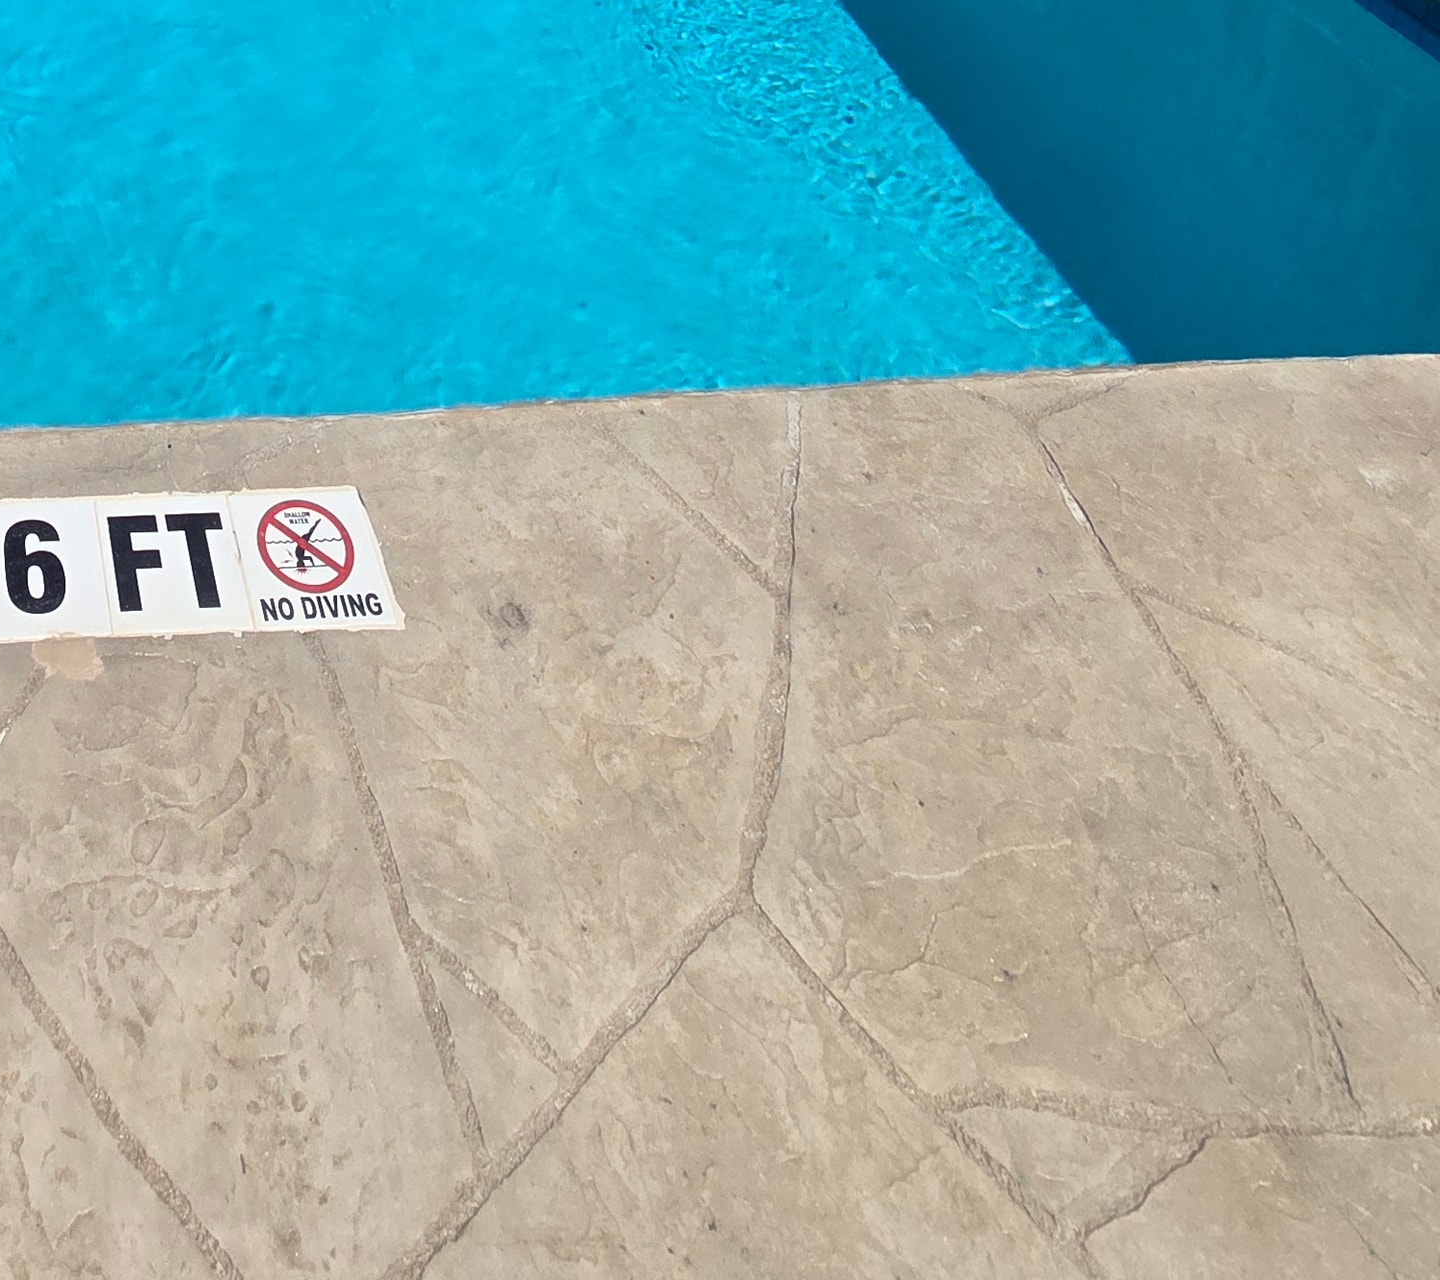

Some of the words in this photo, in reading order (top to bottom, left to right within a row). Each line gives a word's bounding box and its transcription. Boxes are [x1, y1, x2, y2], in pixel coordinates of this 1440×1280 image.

[4, 519, 66, 614] 6
[106, 512, 223, 612] FT
[260, 594, 297, 621] NO
[301, 592, 383, 618] DIVING
